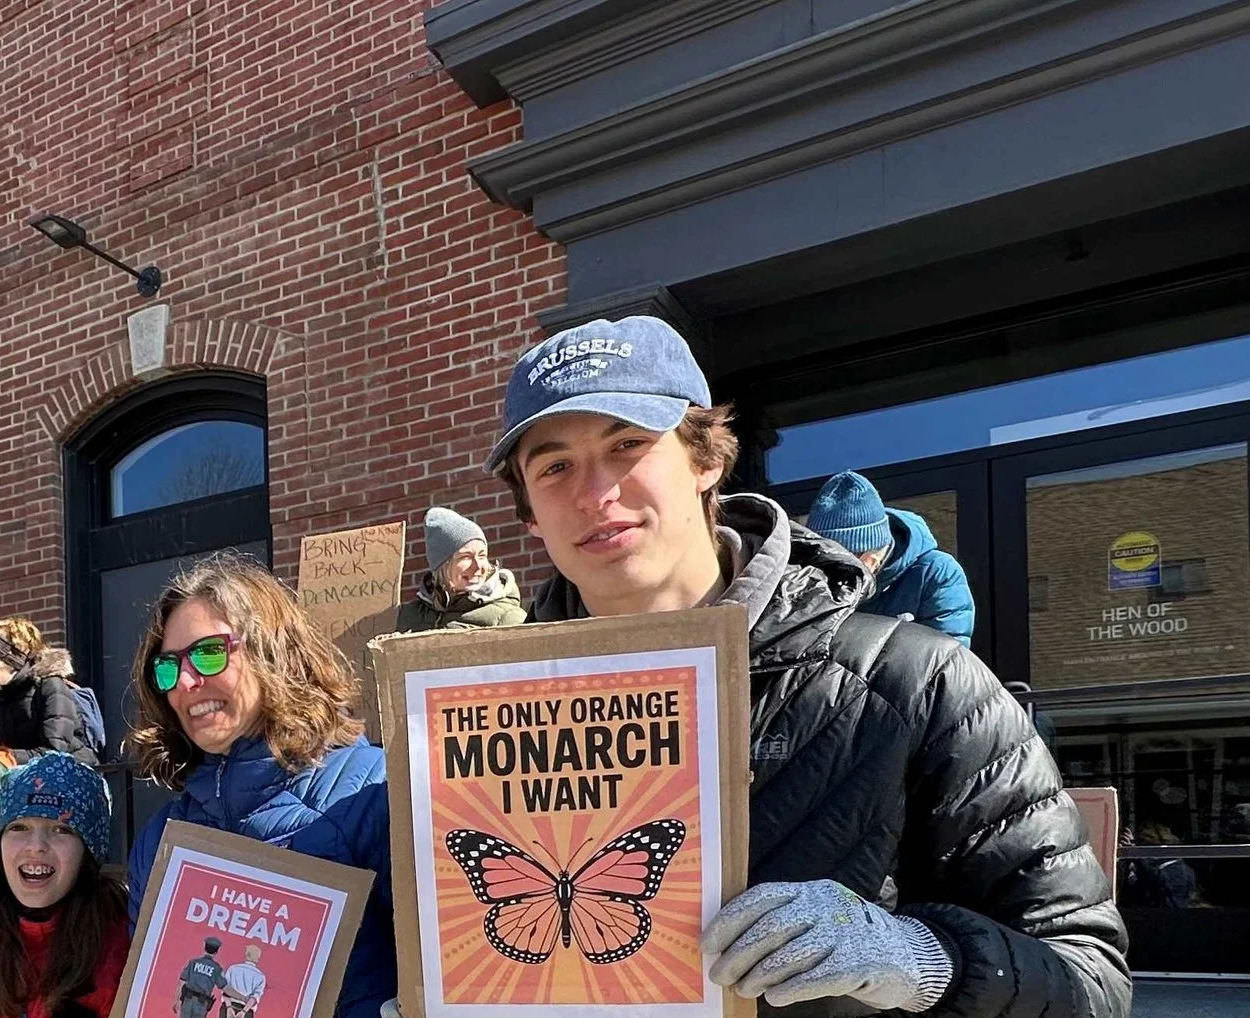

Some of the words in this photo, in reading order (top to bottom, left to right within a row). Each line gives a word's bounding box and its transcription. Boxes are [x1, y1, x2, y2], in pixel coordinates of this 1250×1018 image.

[527, 338, 633, 386] BRUSSELS
[304, 537, 366, 560] BRING
[1086, 624, 1124, 641] THE
[1129, 618, 1188, 637] WOOD
[1102, 606, 1142, 622] HEN
[1147, 602, 1173, 618] OF
[442, 705, 490, 732] THE
[497, 700, 562, 728] ONLY
[570, 690, 679, 723] ORANGE
[444, 720, 680, 779] MONARCH
[502, 780, 512, 814] I
[521, 773, 623, 813] WANT
[210, 884, 218, 899] I
[221, 887, 273, 914] HAVE
[275, 904, 290, 920] A
[185, 897, 302, 952] DREAM
[194, 962, 215, 977] POLICE
